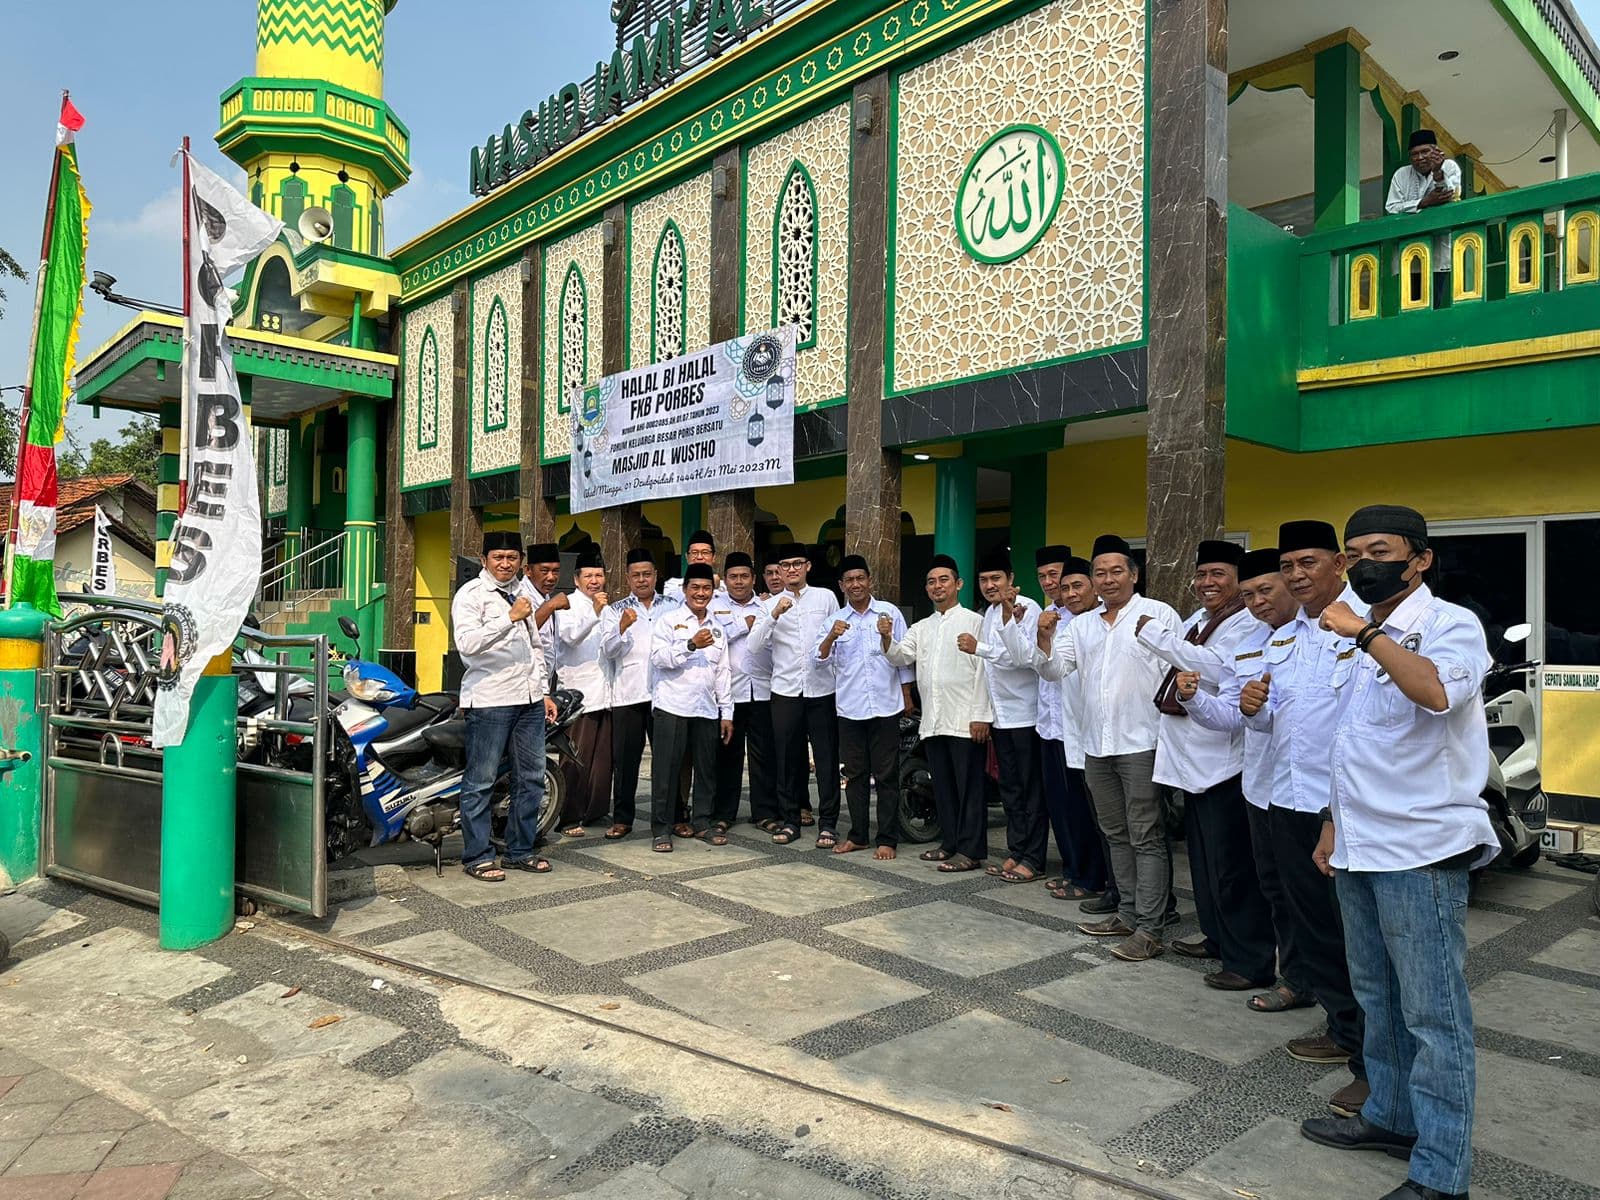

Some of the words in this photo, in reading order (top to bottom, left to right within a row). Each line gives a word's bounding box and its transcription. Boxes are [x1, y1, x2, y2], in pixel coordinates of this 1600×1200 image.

[470, 83, 580, 195] MASJID
[621, 372, 658, 399] HALAL
[662, 367, 675, 389] BI
[678, 354, 716, 384] HALAL
[630, 396, 652, 420] FKB
[655, 382, 706, 414] PORBES
[705, 406, 719, 416] 2023
[609, 440, 627, 453] FORUM
[628, 434, 655, 448] KELUARGA
[657, 430, 677, 443] BESAR
[678, 425, 695, 440] PORIS
[696, 420, 723, 435] BERSATU
[612, 452, 649, 475] MASJID
[652, 449, 666, 467] AL
[671, 439, 716, 465] WUSTHO
[719, 464, 737, 476] Mei
[1544, 673, 1562, 687] SEPATU
[1563, 673, 1581, 687] SANDAL
[1582, 673, 1599, 687] HARAP
[384, 794, 415, 812] SUZUKI
[1541, 831, 1556, 847] CI
